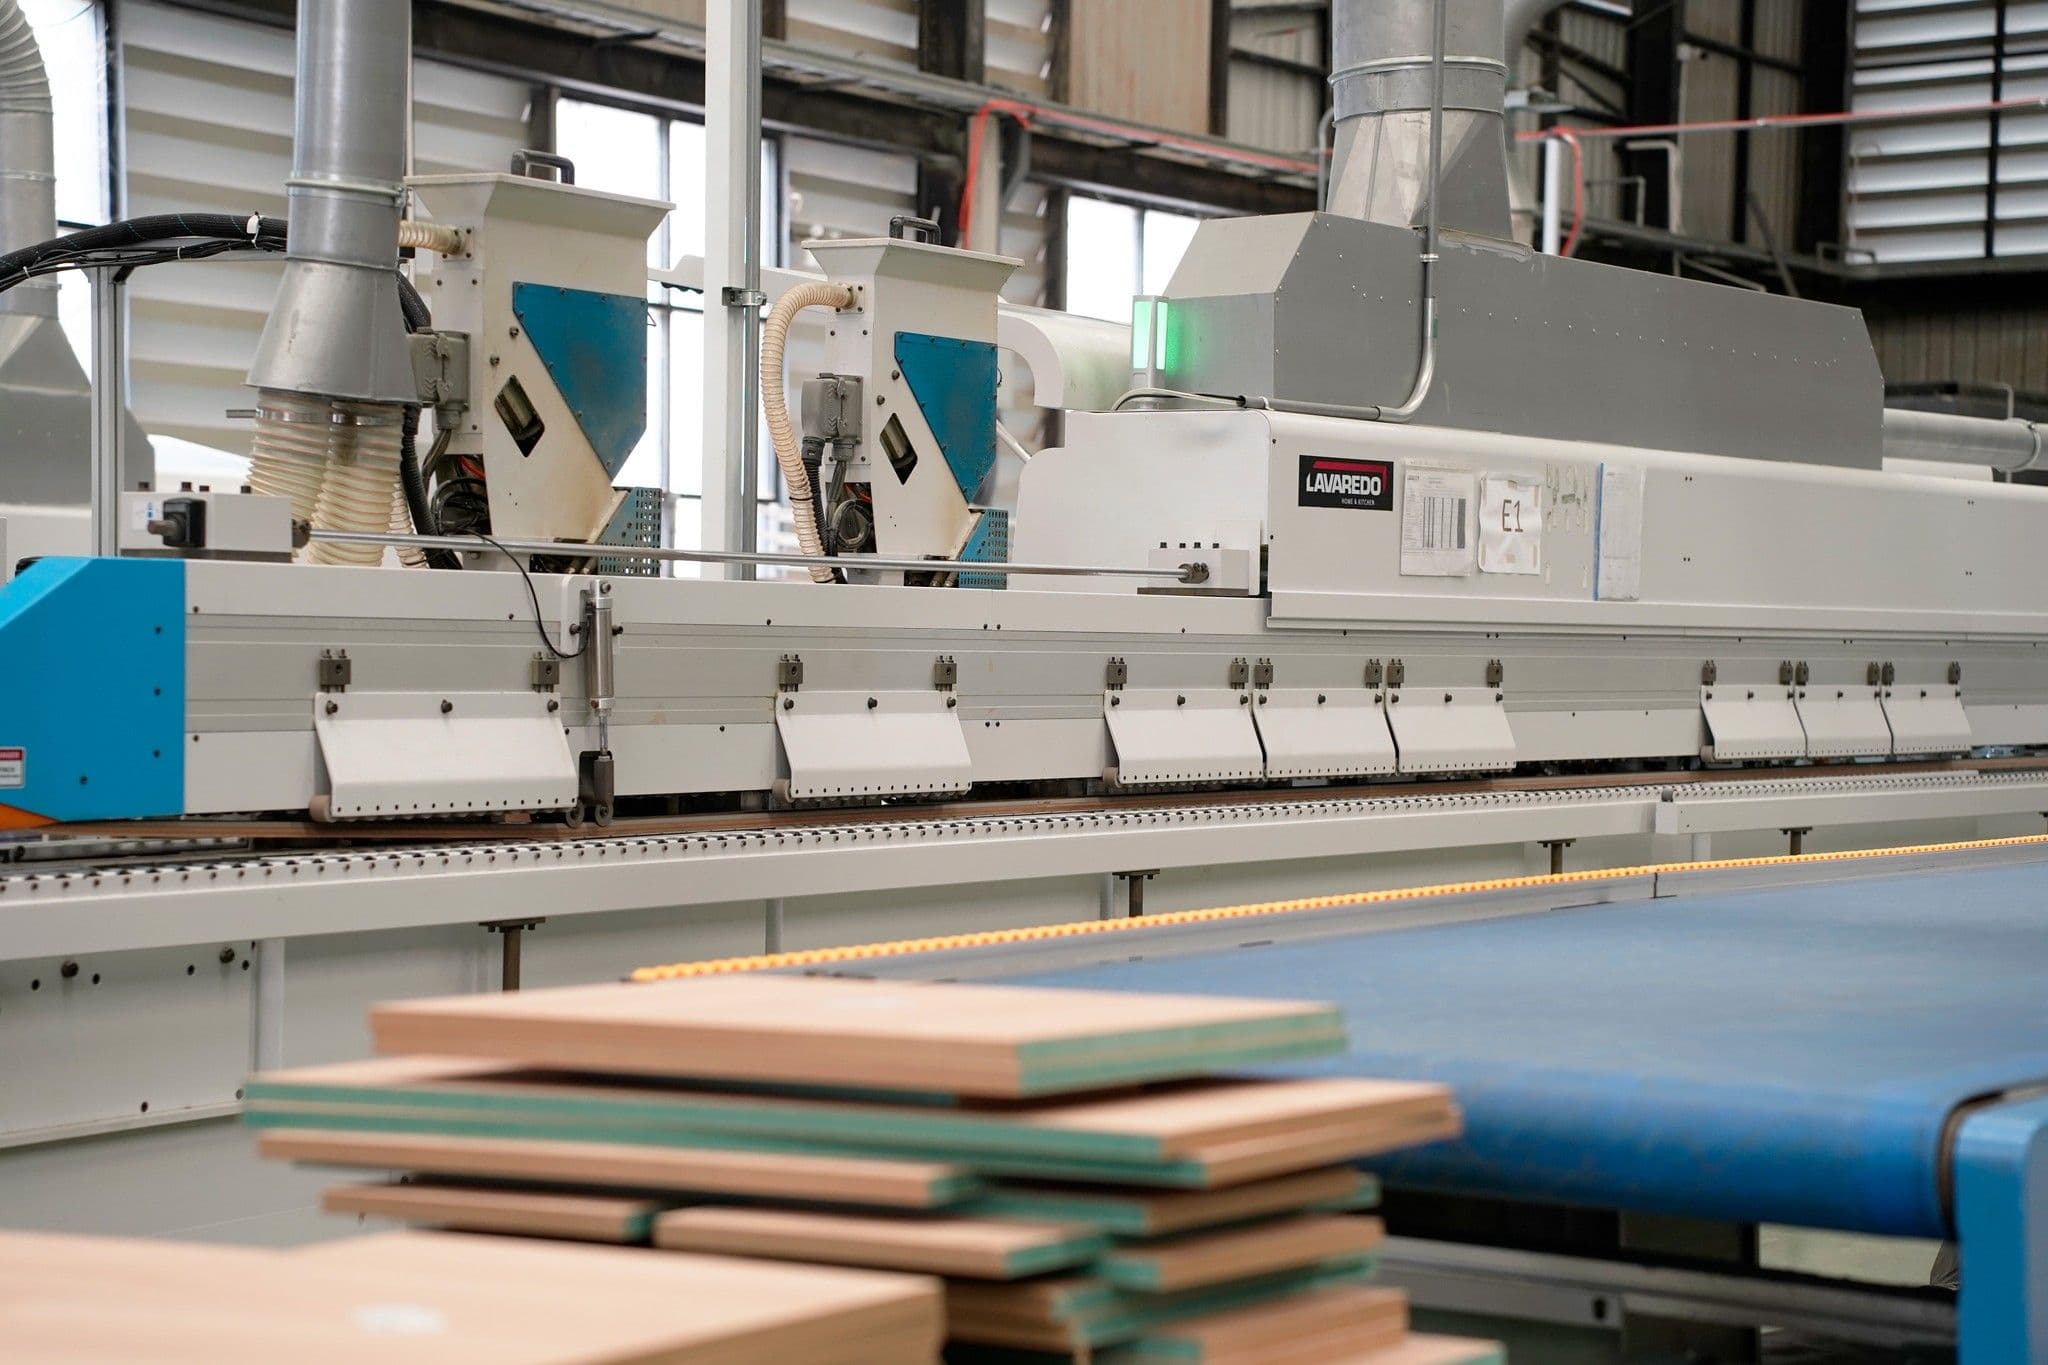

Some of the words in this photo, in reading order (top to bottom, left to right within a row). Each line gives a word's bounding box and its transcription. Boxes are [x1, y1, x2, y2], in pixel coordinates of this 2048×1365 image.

[1306, 472, 1382, 496] LAVAREDO
[1341, 497, 1354, 505] HOME
[1358, 498, 1375, 506] KITCHEN
[1502, 498, 1524, 533] E1
